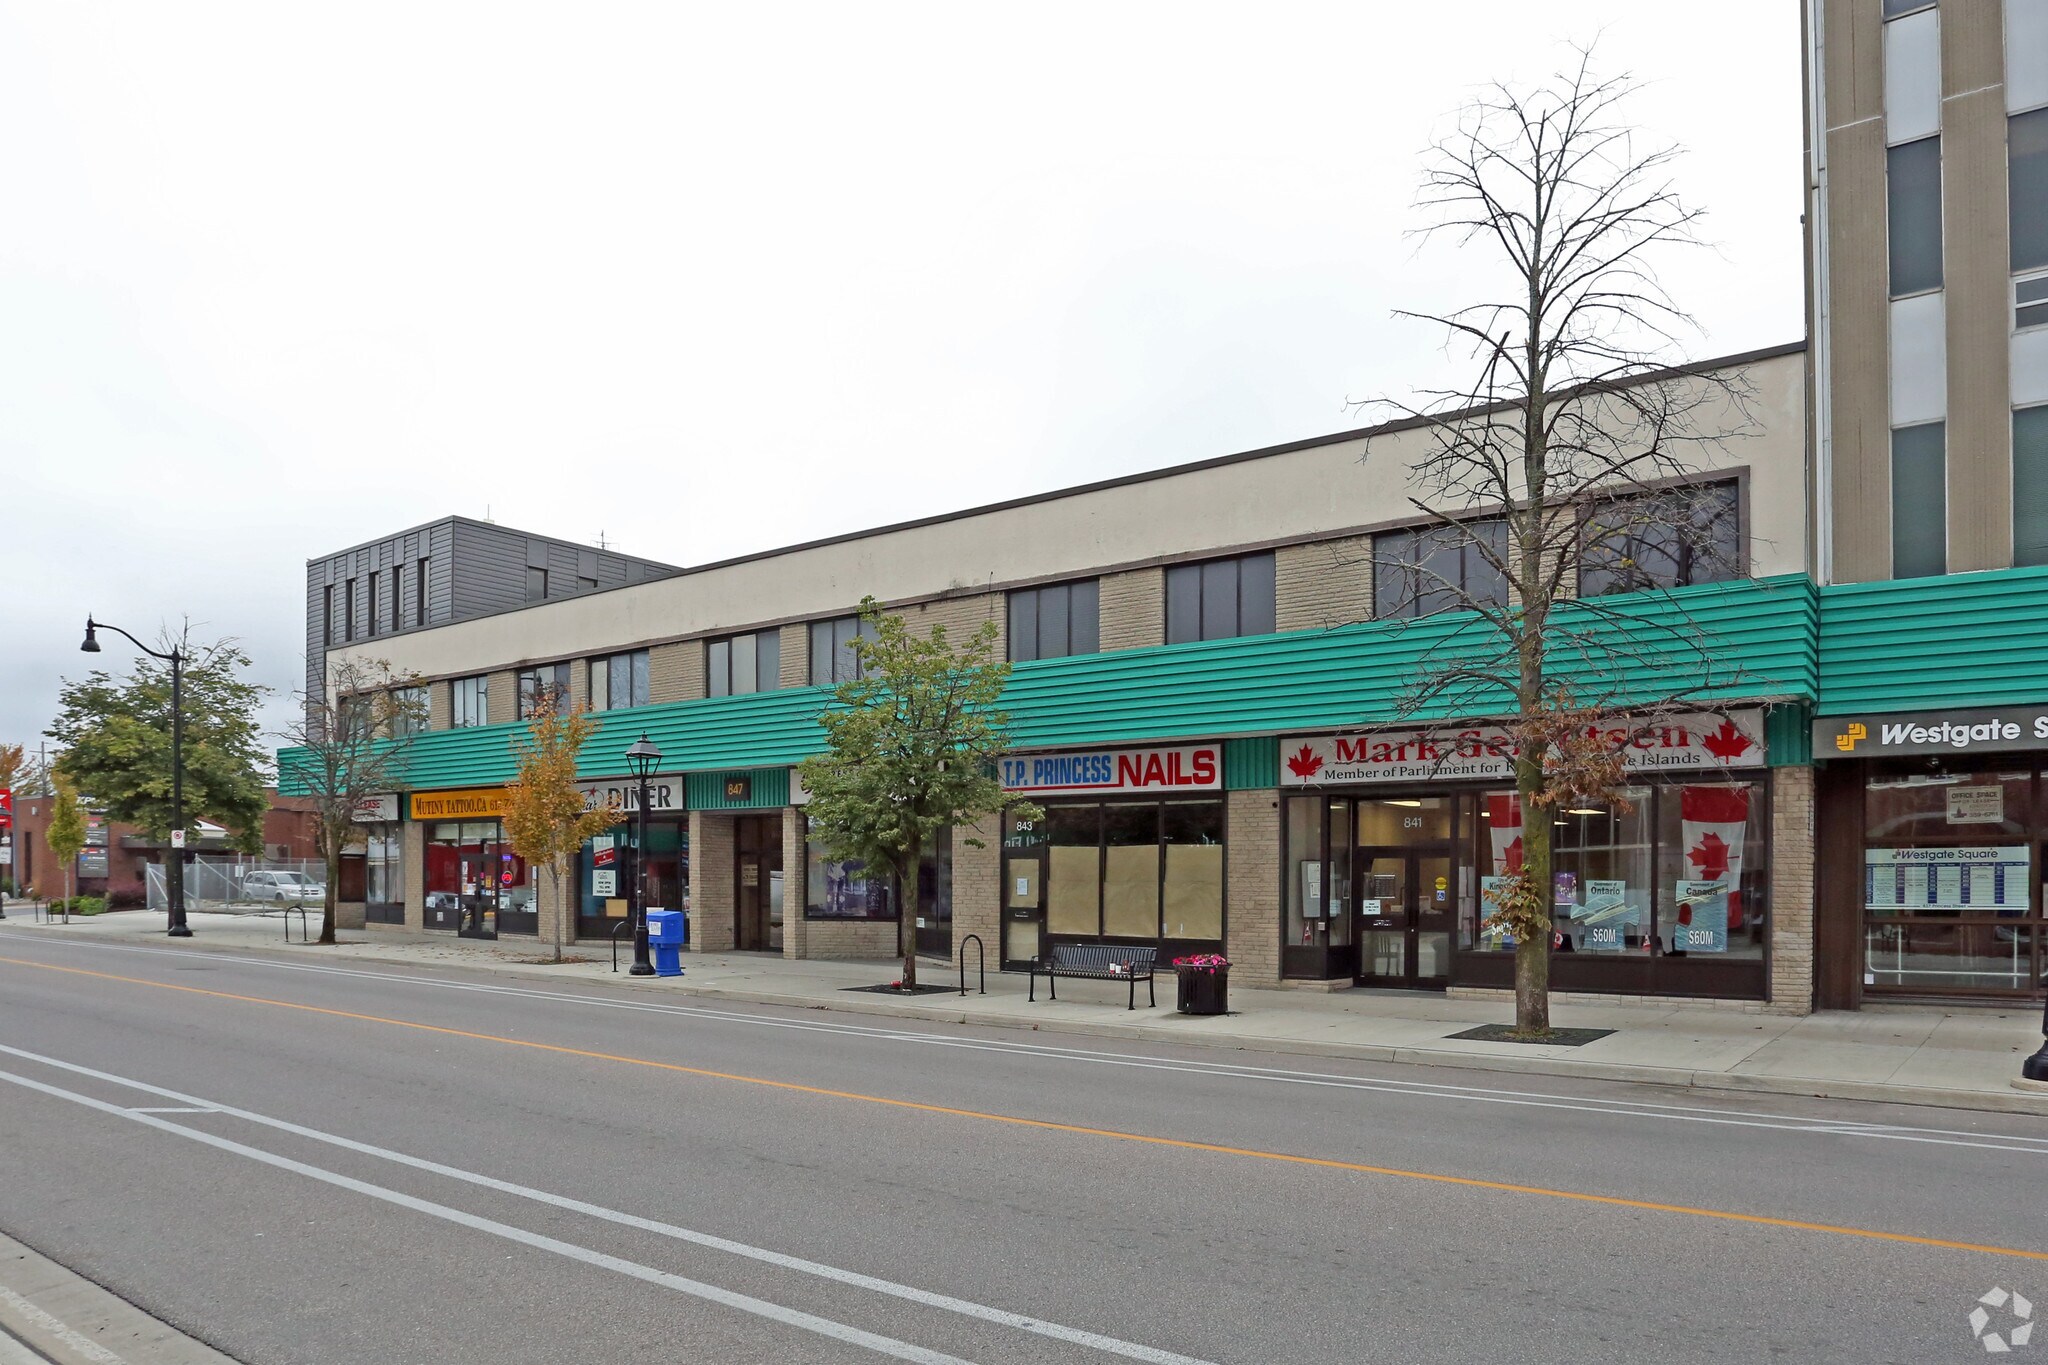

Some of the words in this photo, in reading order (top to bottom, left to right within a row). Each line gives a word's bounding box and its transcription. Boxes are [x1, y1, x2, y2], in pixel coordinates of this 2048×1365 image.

[1881, 718, 2021, 748] Westgate
[1335, 732, 1440, 764] Mark
[1641, 751, 1700, 766] Islands
[1004, 760, 1028, 787] T.P.
[1034, 755, 1112, 786] PRINCESS
[1118, 750, 1216, 787] NAILS
[1324, 767, 1379, 780] Member
[1382, 766, 1396, 777] of
[1480, 761, 1500, 773] for
[727, 783, 744, 796] 847
[607, 784, 671, 810] DINER
[1016, 821, 1033, 831] 843
[1404, 817, 1422, 828] 841
[1901, 850, 1955, 861] Westgate
[1957, 849, 1999, 860] Square
[1590, 886, 1621, 896] Ontario
[1686, 887, 1718, 896] Canada
